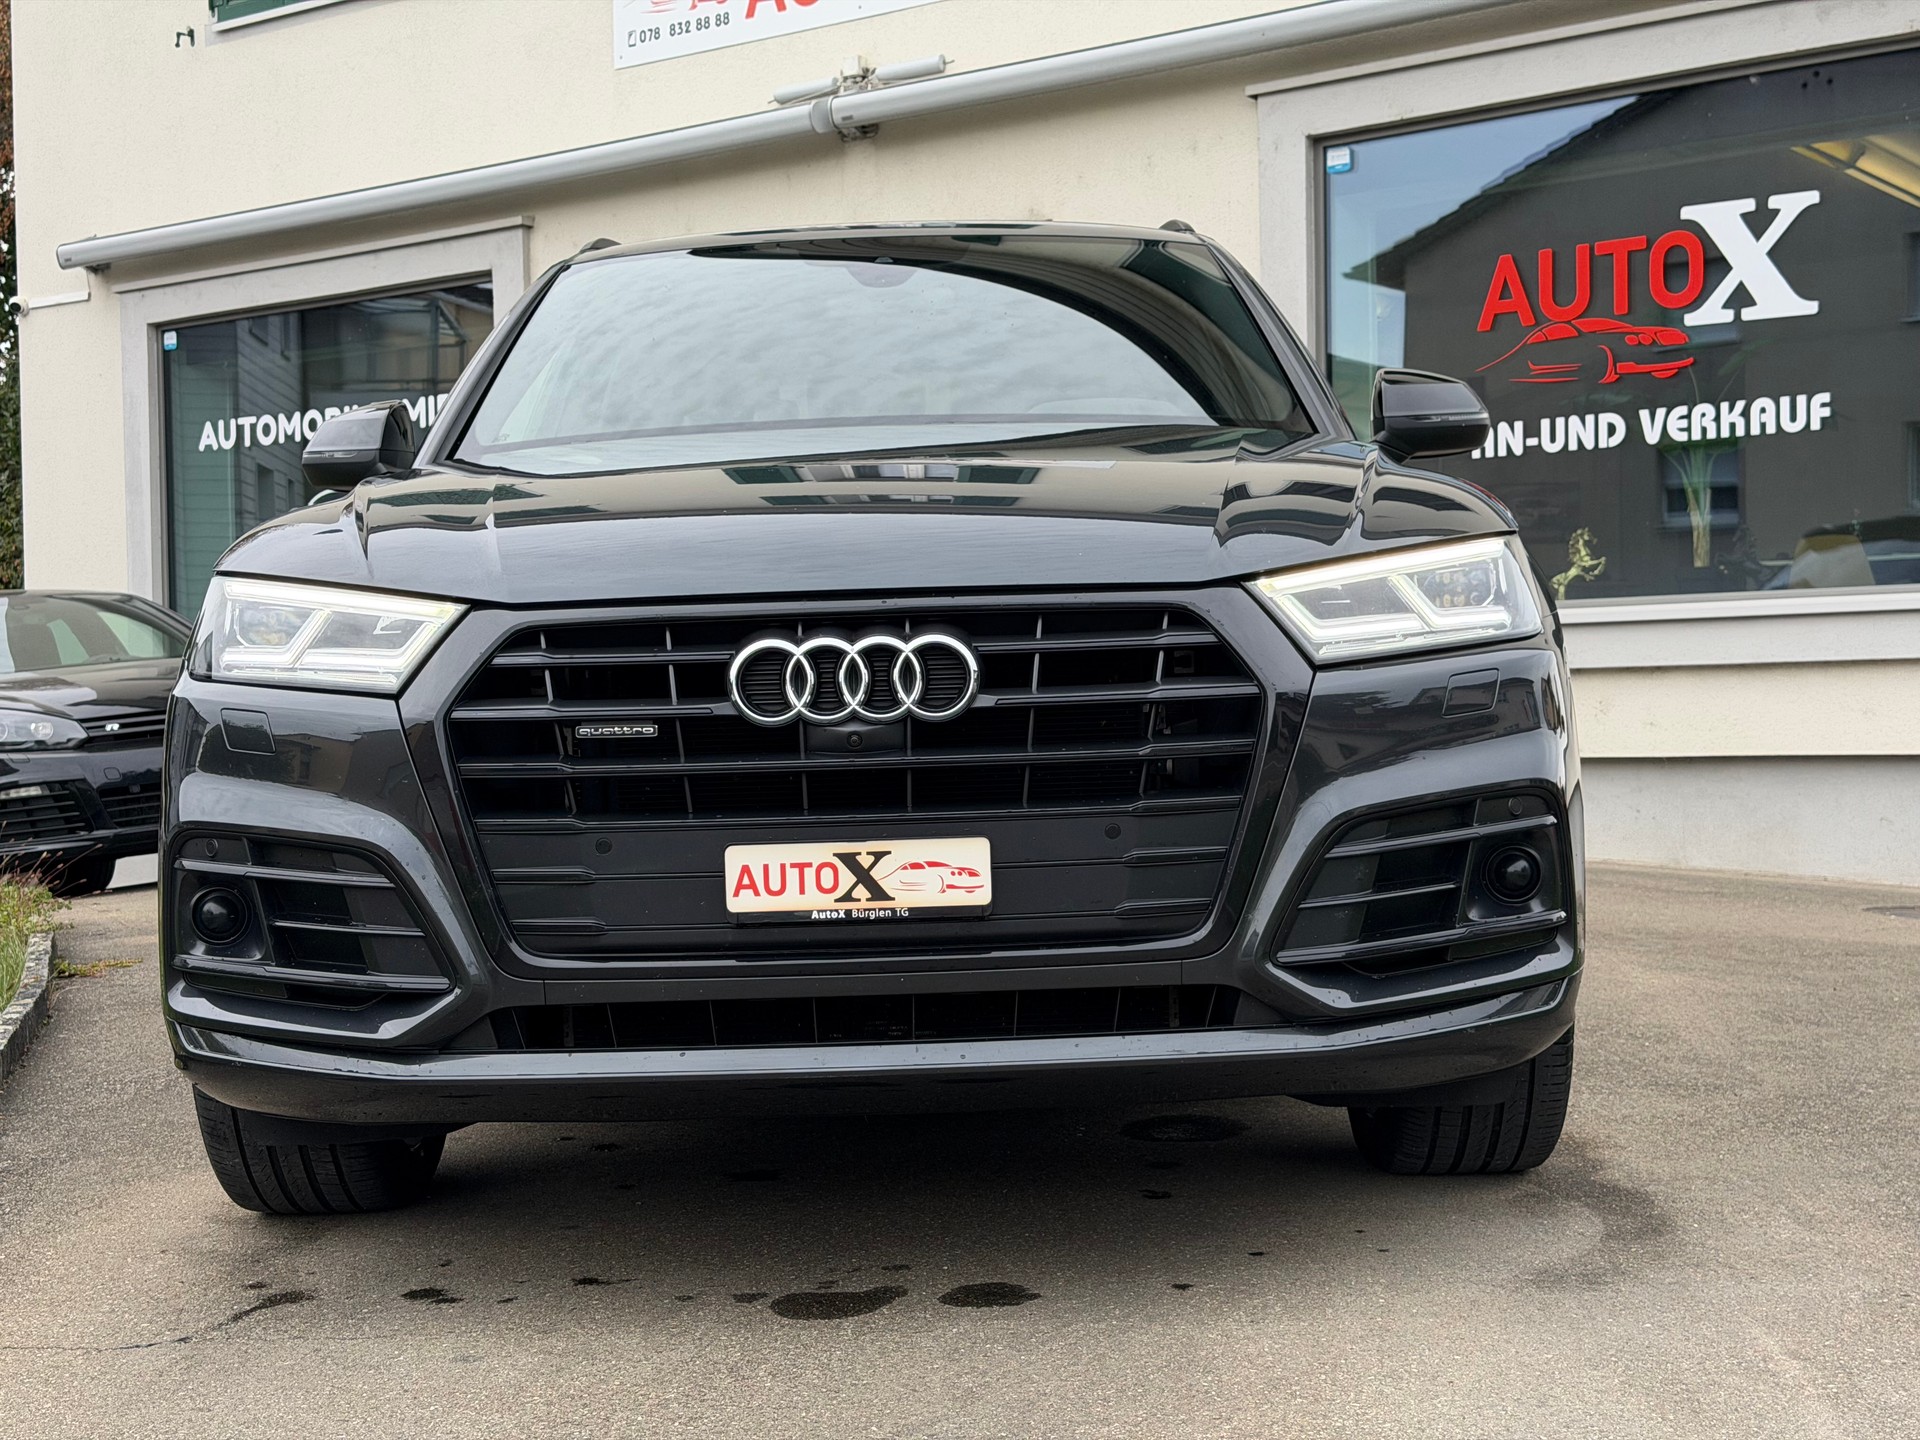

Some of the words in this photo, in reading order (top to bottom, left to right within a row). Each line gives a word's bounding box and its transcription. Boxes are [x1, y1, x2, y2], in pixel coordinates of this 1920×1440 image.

[639, 27, 661, 43] 078
[669, 20, 691, 37] 832
[696, 16, 710, 31] 88
[715, 12, 730, 26] 88
[1639, 392, 1831, 446] VERKAUF
[579, 726, 654, 736] quattro
[732, 850, 896, 903] AUTOX
[811, 909, 846, 919] AutoX
[852, 908, 892, 919] Bürglen
[895, 908, 909, 916] TG
